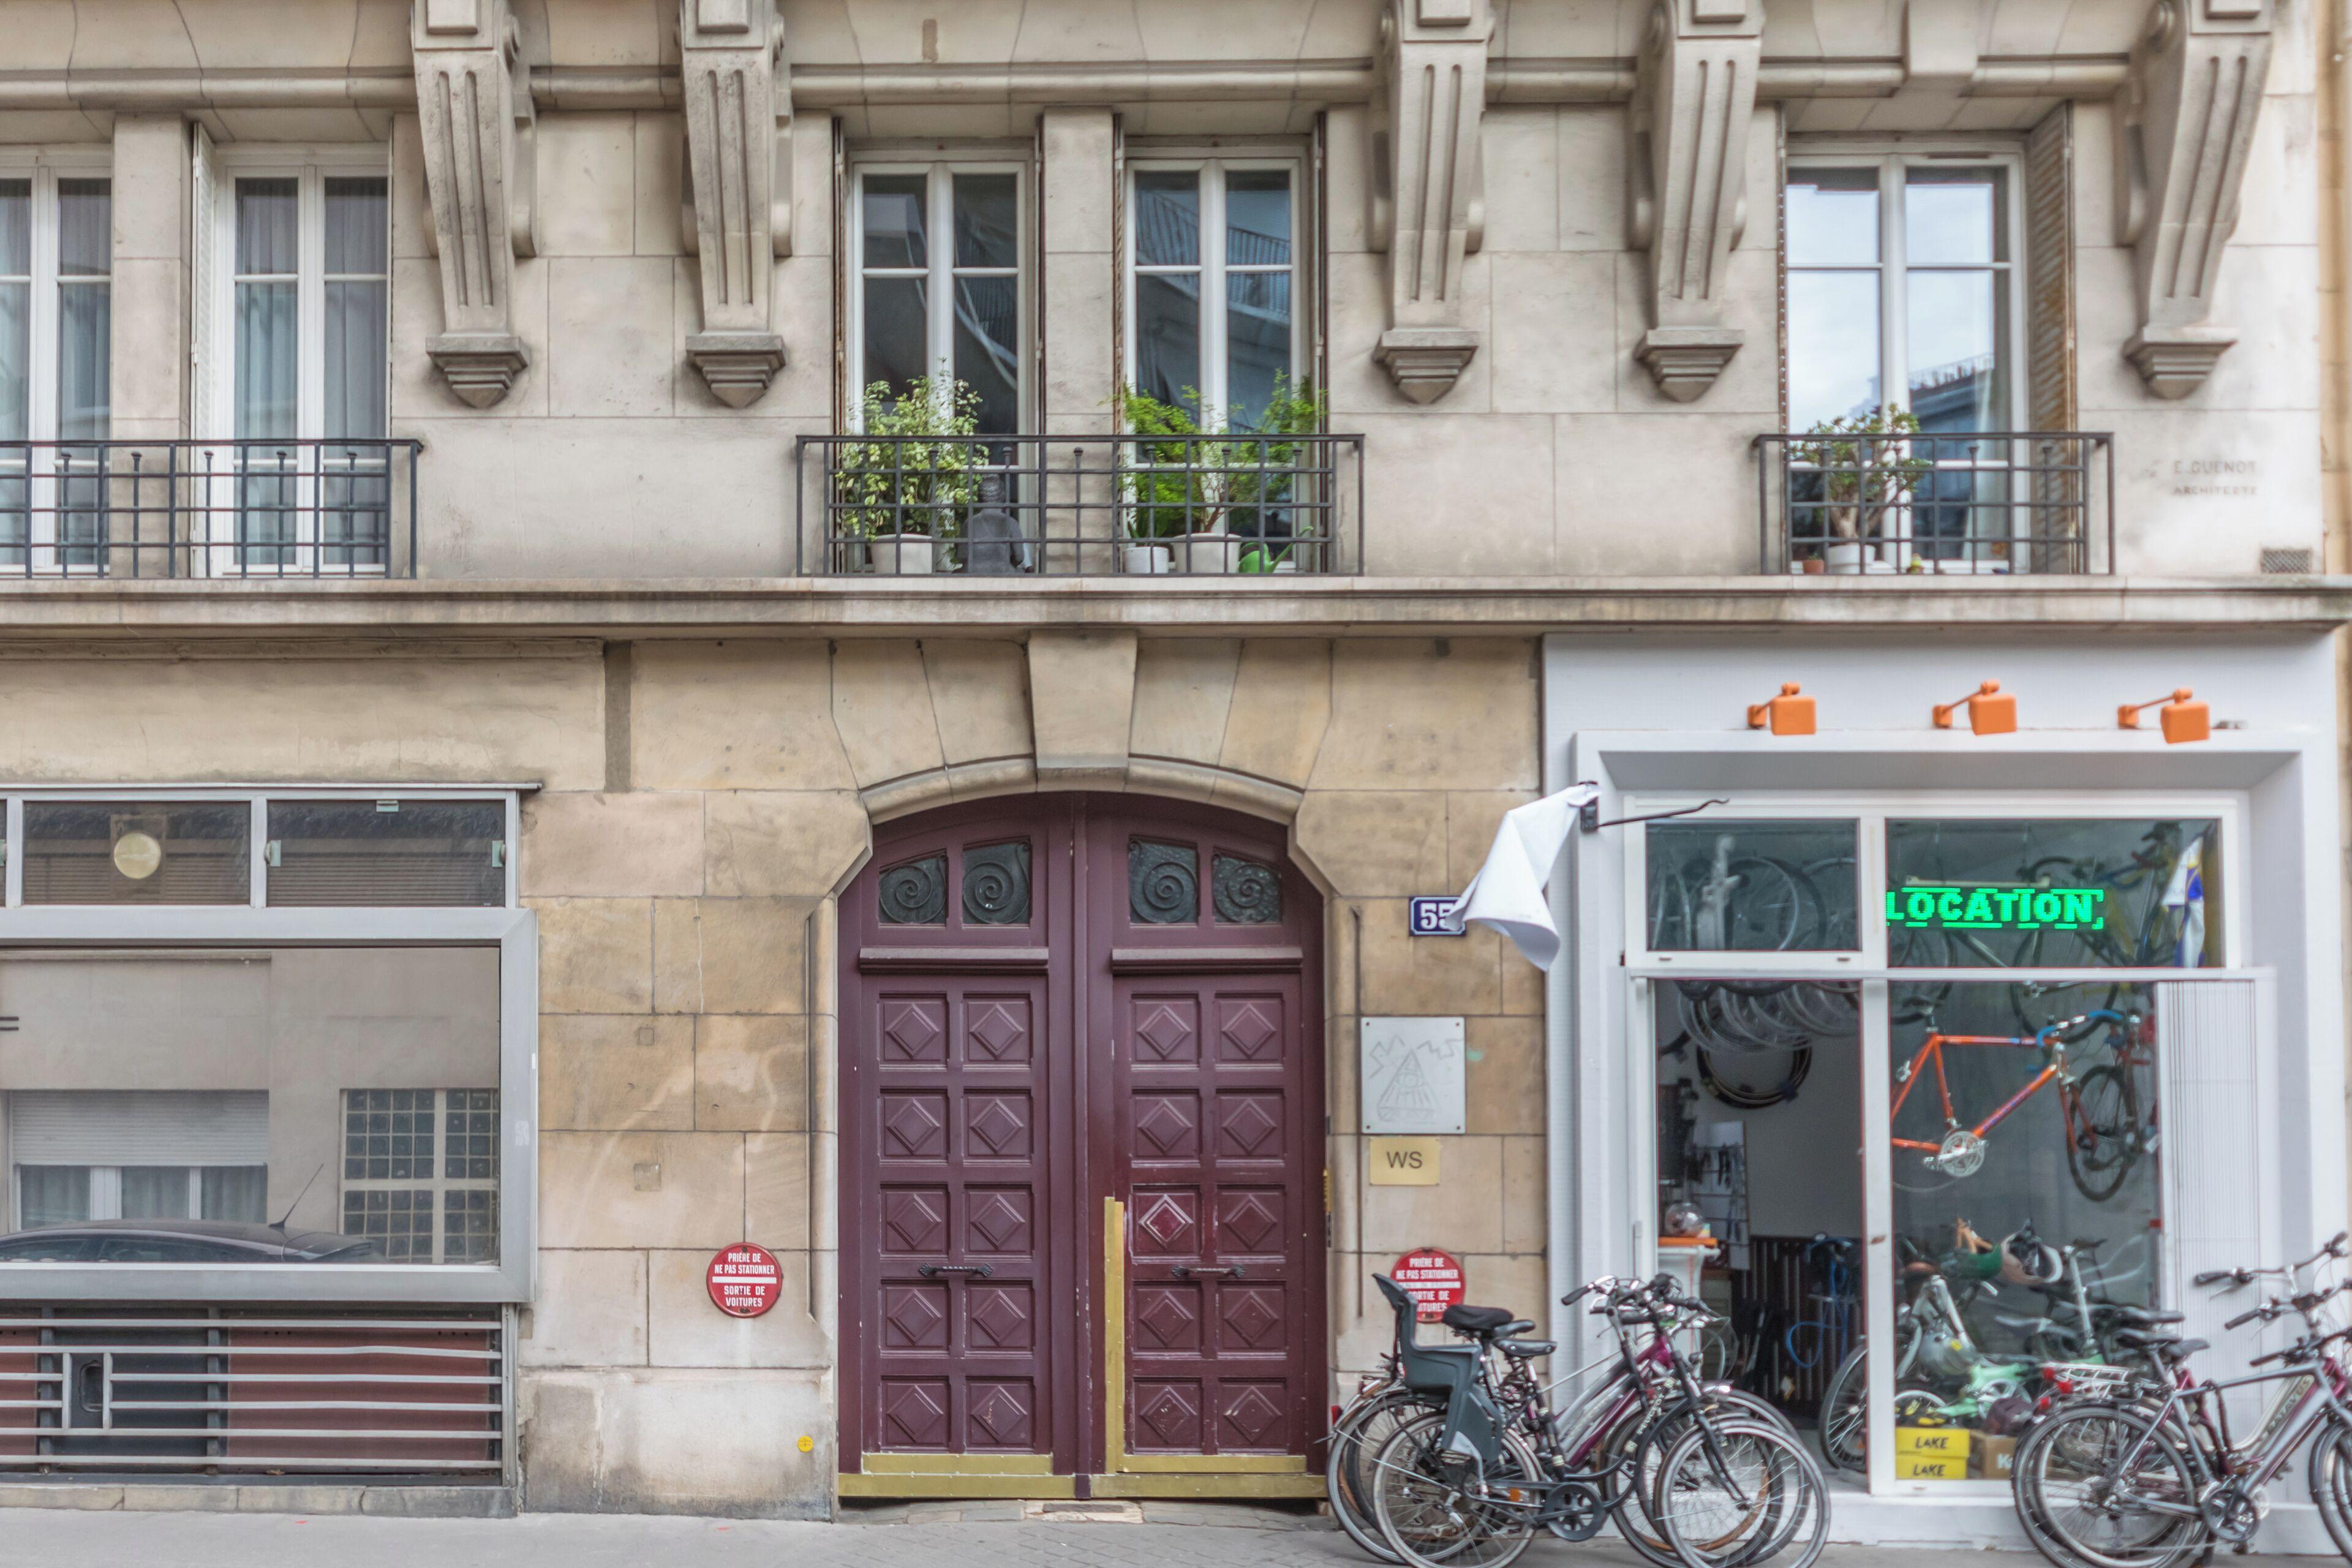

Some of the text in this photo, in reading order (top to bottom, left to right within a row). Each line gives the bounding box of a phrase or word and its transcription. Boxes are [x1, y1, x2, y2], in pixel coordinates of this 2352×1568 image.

[2173, 486, 2257, 495] ARCHITECTE
[1886, 891, 2092, 922] LOCATION
[1386, 1151, 1423, 1169] WS
[752, 1253, 761, 1263] DE
[1434, 1257, 1445, 1267] DE
[714, 1264, 775, 1275] NE PAS STATIONNER
[1395, 1269, 1459, 1280] NE PAS STATIONNER
[723, 1285, 766, 1295] SORTIE DE
[1438, 1291, 1450, 1301] DE
[725, 1297, 763, 1307] VOITURES
[1915, 1436, 1950, 1450] LAKE
[1913, 1464, 1947, 1477] LAKE
